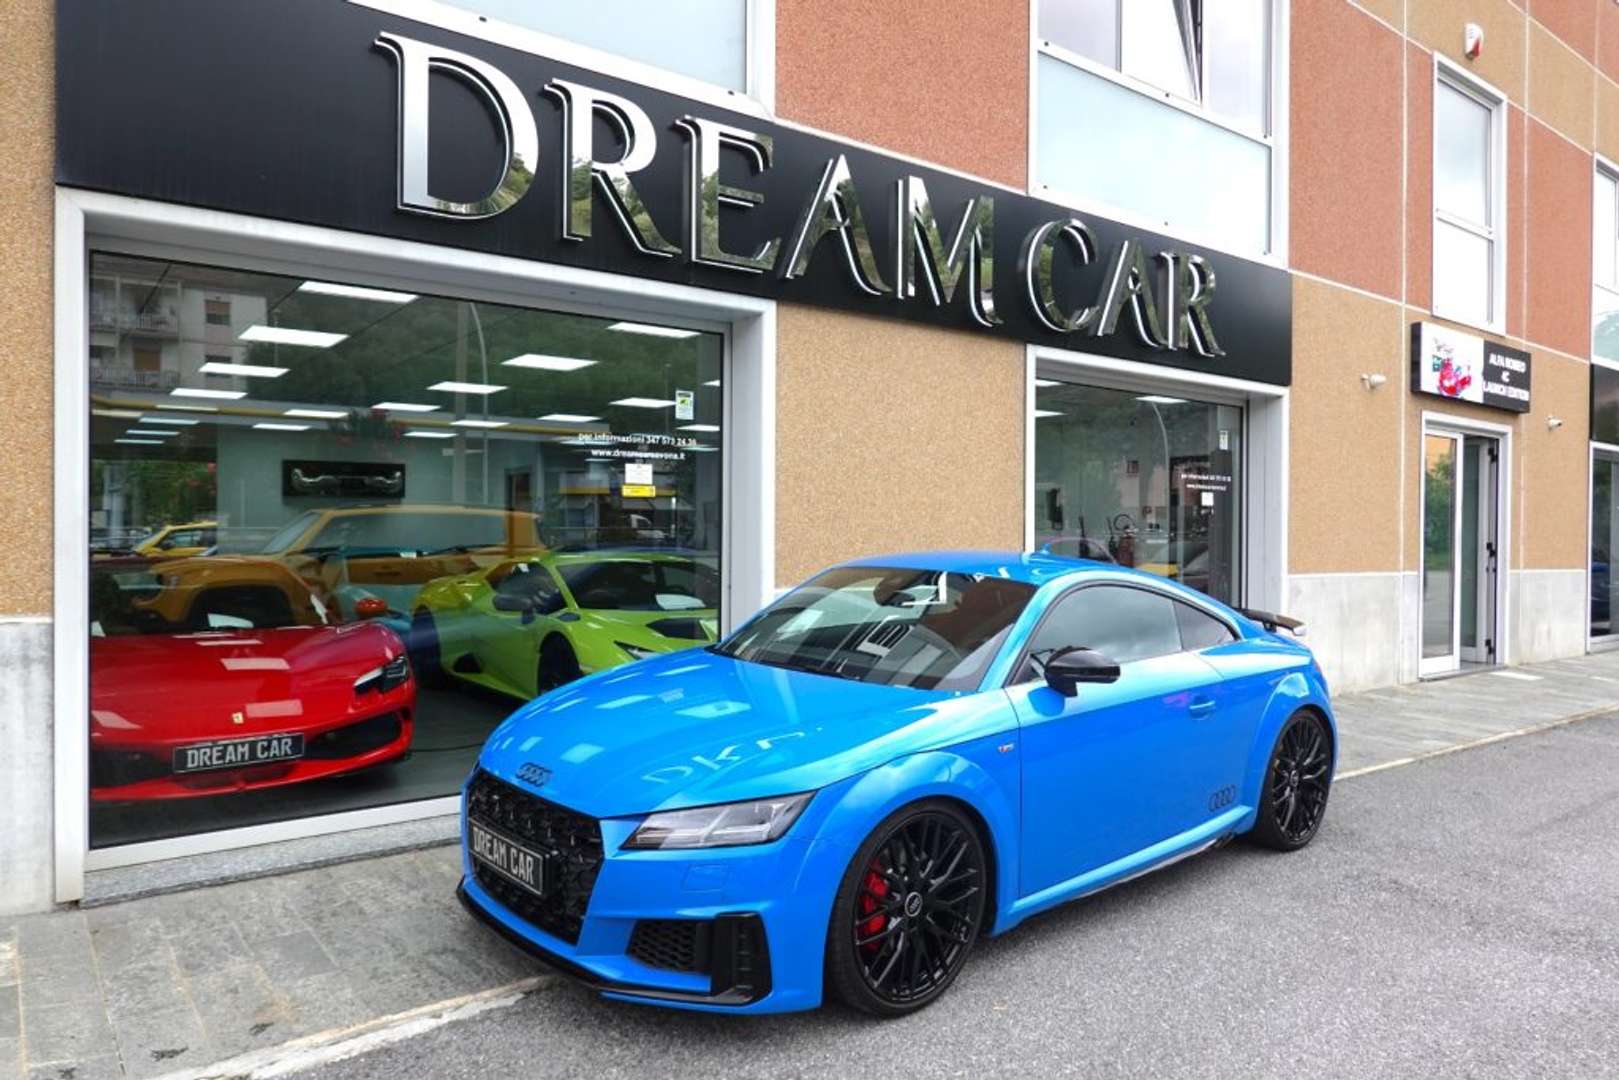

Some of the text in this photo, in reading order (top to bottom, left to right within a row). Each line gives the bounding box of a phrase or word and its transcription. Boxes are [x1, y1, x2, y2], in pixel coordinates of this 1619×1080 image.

[373, 32, 1226, 358] DREAM CAR
[186, 738, 293, 768] DREAM CAR
[472, 826, 534, 885] DREAM CAR
